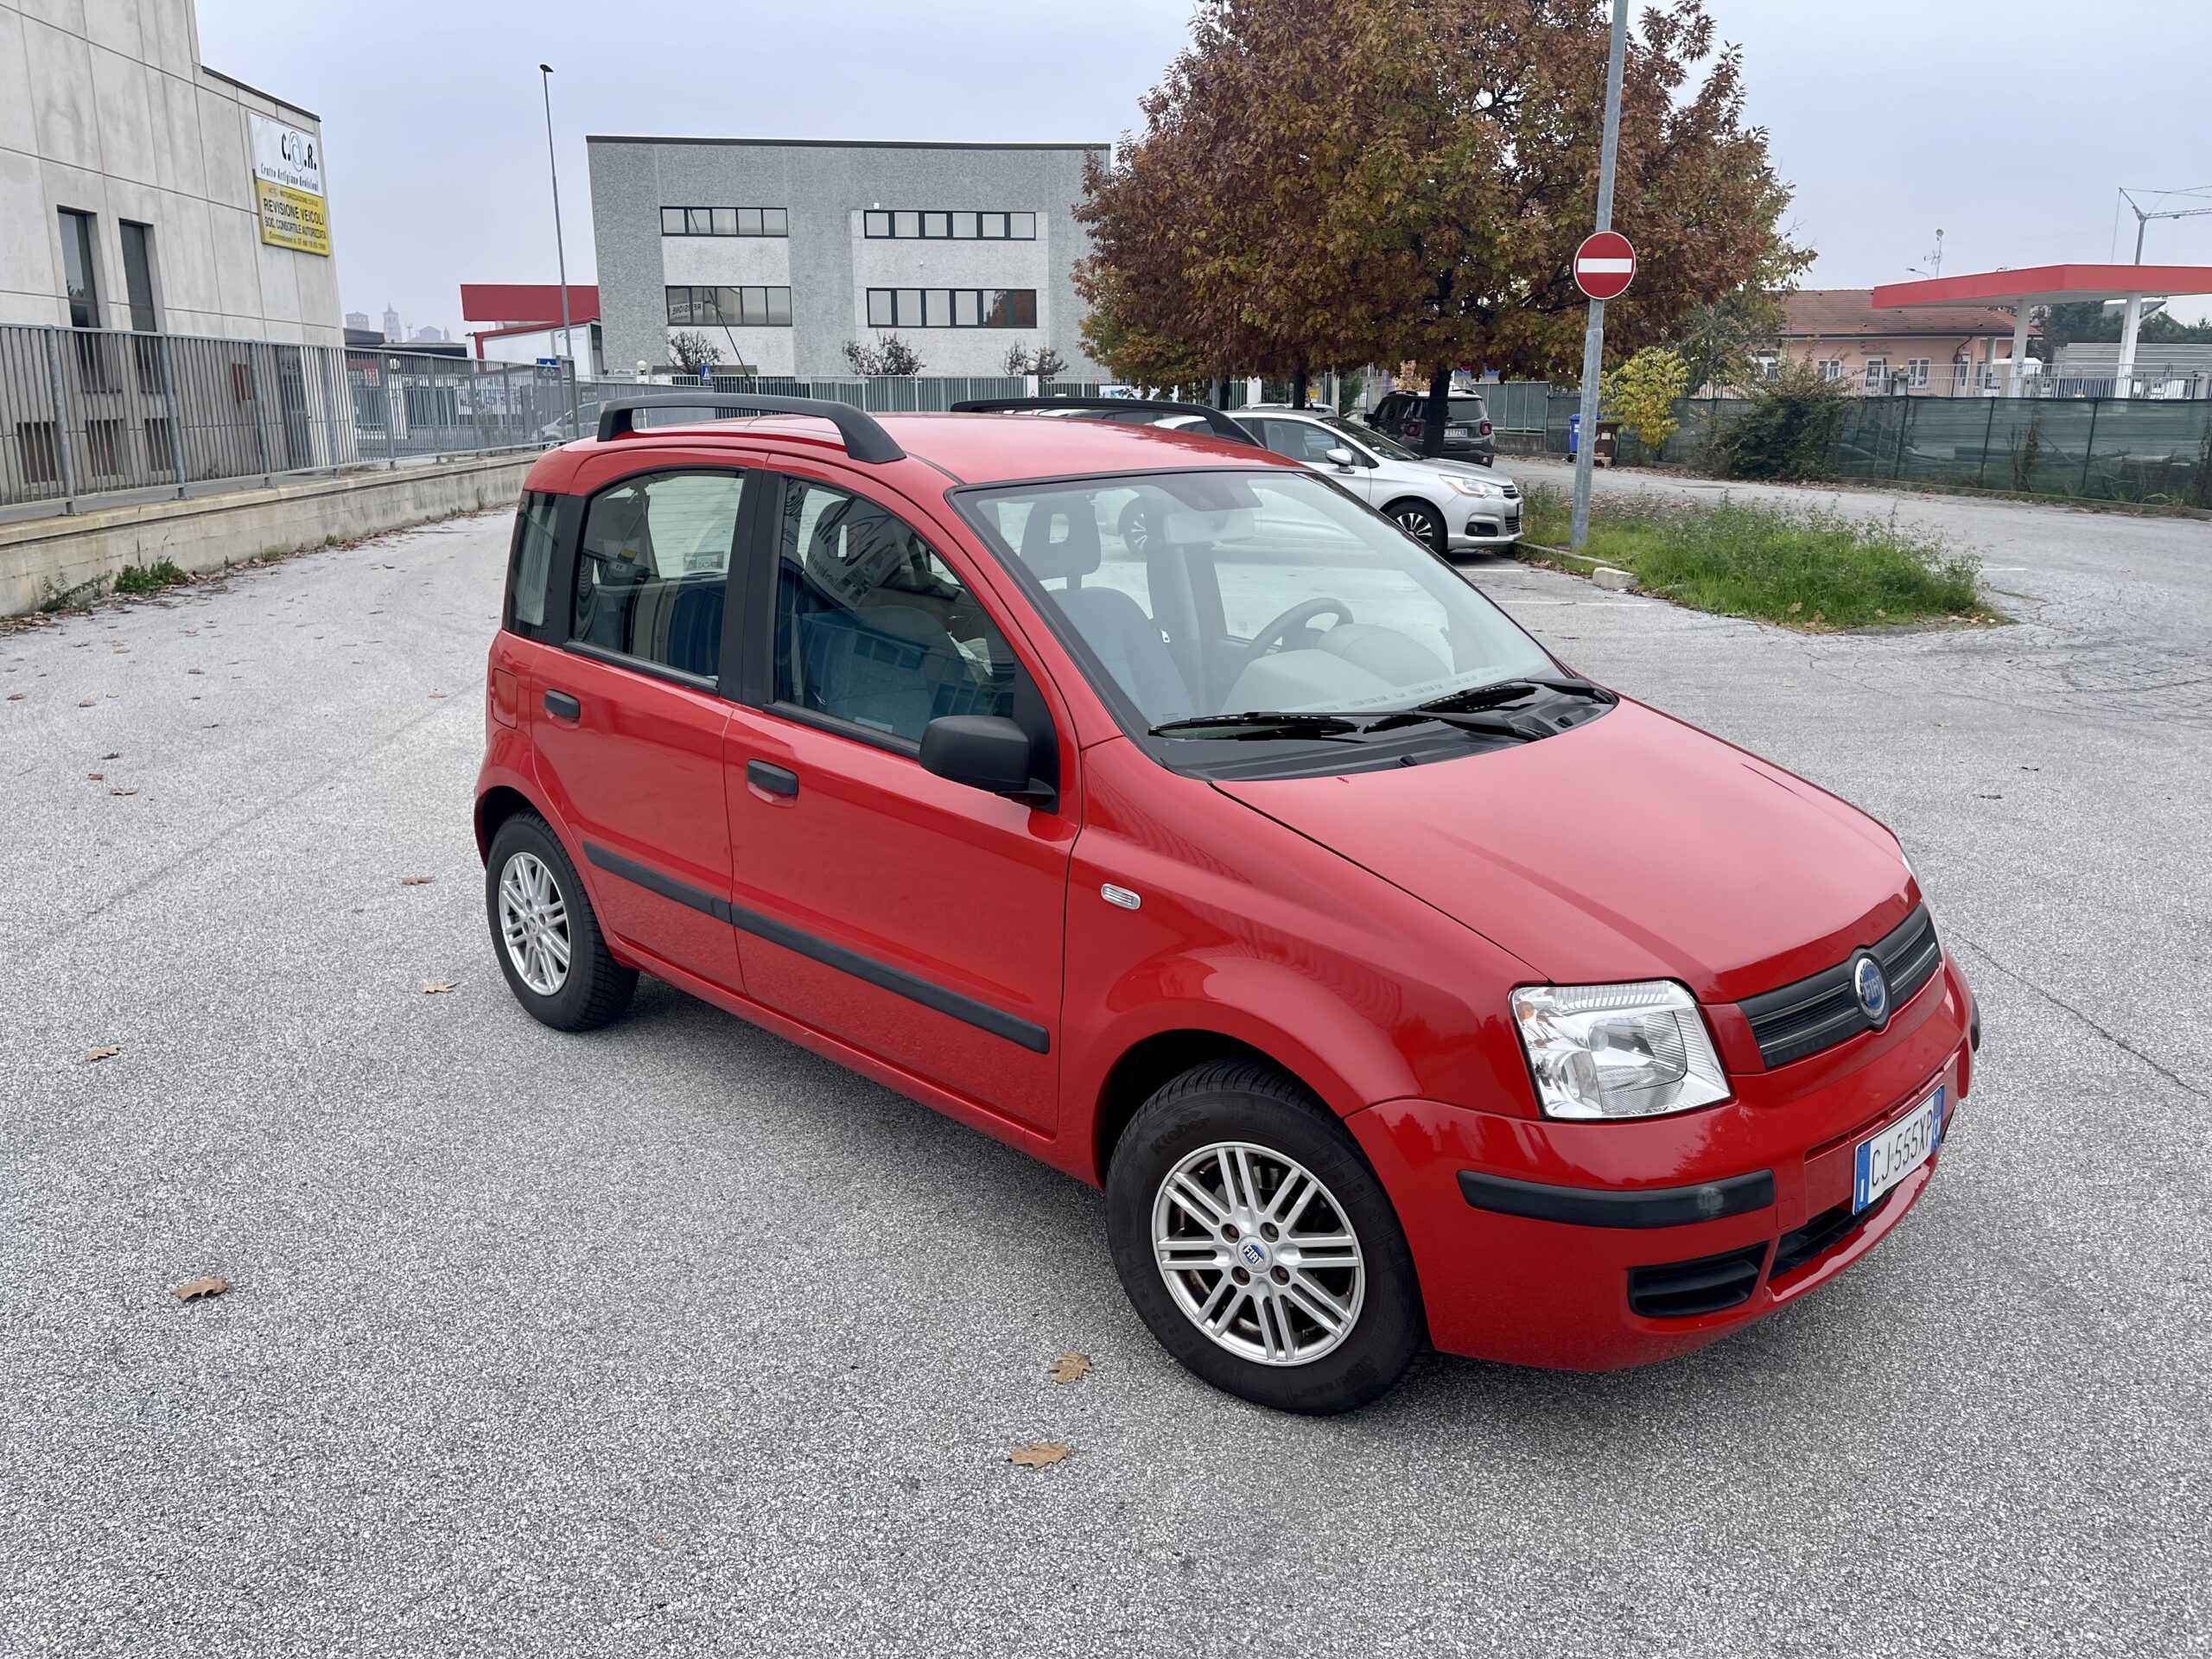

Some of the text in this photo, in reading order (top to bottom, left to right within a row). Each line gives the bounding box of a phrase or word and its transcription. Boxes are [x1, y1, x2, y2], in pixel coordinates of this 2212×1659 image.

[263, 198, 325, 226] REVISIONE VEICOLI
[1863, 975, 1884, 1002] FIAT
[1872, 1109, 1933, 1187] CJ555XP
[1243, 1244, 1264, 1265] FIAT
